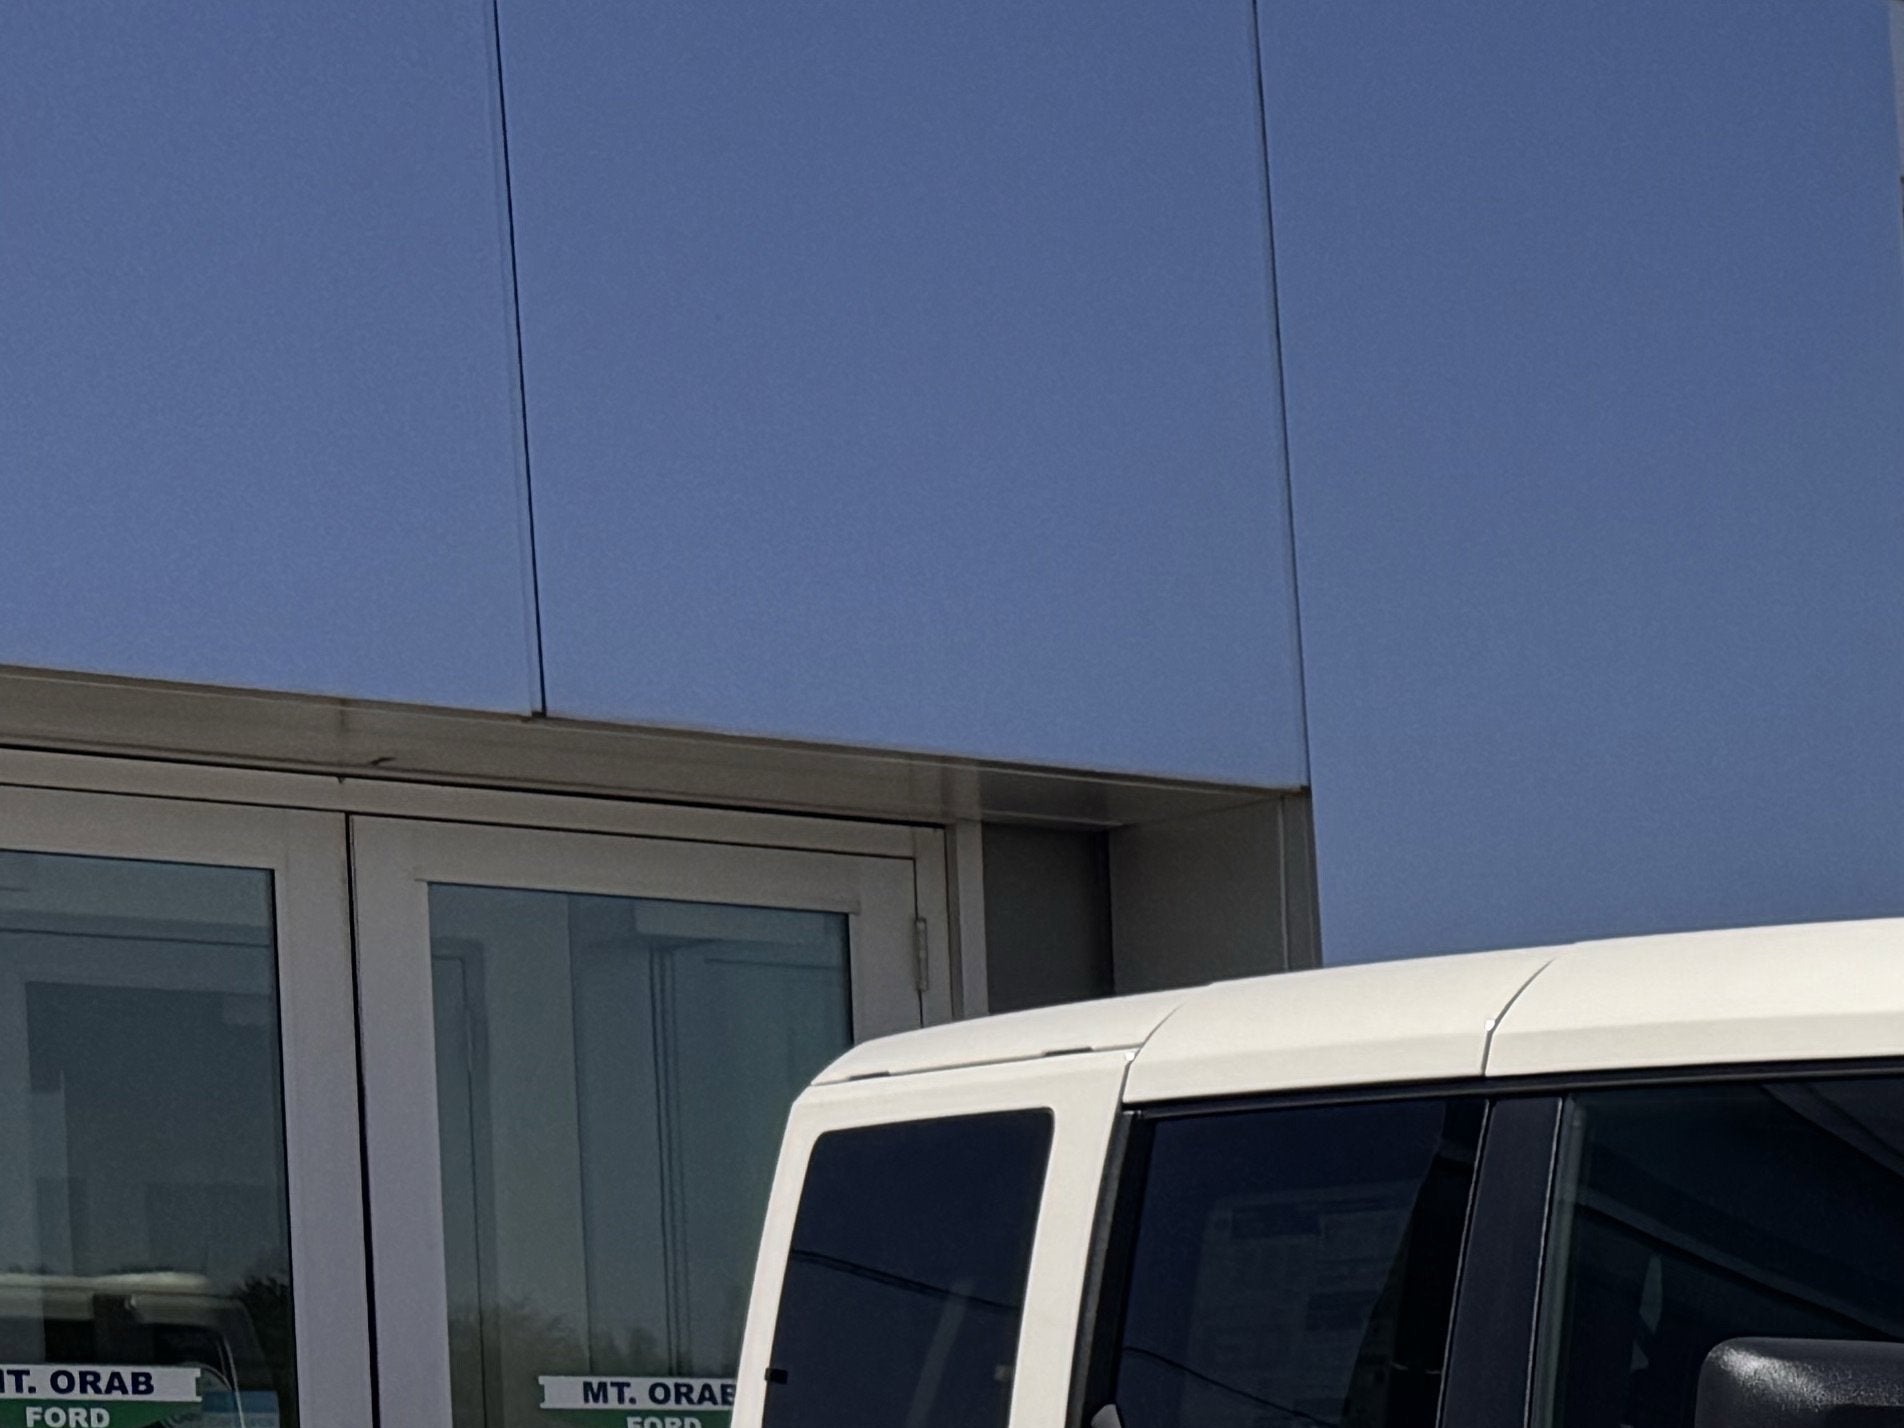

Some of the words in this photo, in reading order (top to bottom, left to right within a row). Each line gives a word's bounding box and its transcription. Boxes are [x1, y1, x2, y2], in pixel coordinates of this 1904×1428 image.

[50, 1370, 154, 1395] ORAB
[582, 1380, 637, 1405] MT.
[25, 1406, 111, 1428] FORD
